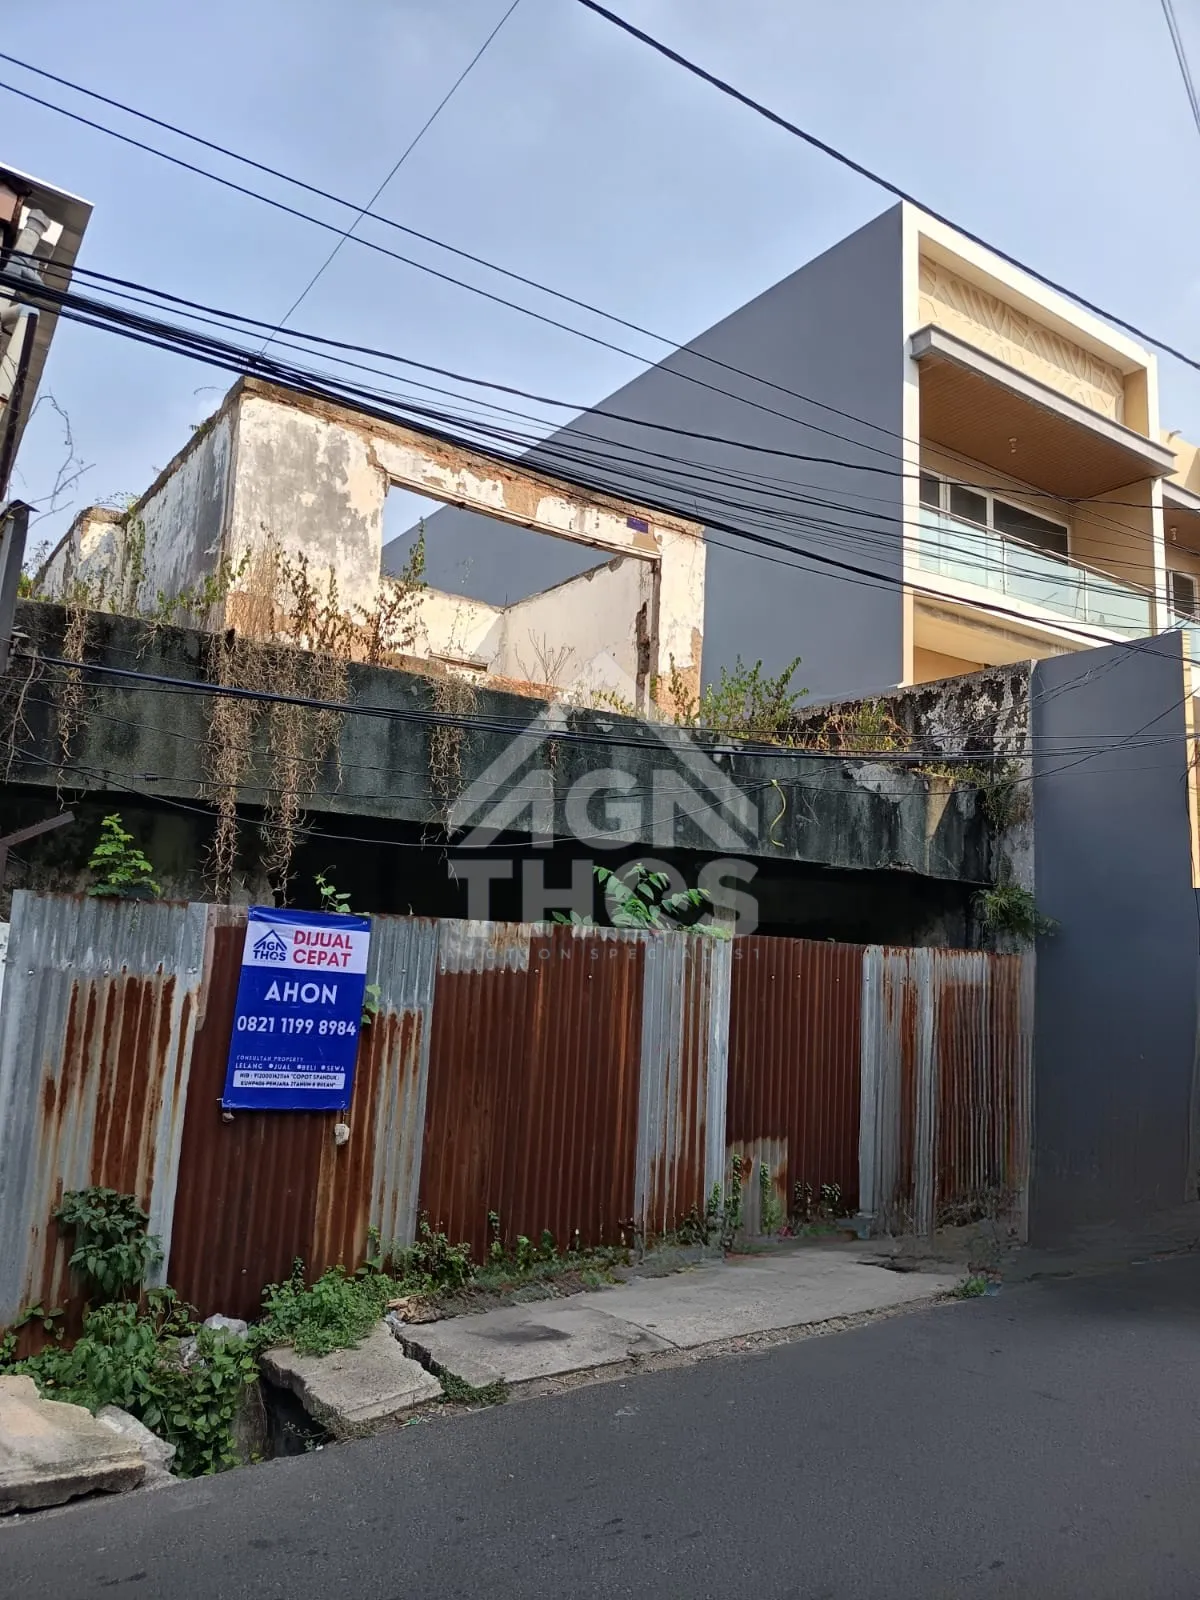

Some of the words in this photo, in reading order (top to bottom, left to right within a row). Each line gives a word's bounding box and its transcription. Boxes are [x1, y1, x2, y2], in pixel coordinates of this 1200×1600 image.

[293, 930, 353, 950] DIJUAL
[252, 949, 287, 962] THOS
[292, 949, 352, 968] CEPAT
[263, 980, 338, 1005] AHON
[236, 1015, 275, 1033] 0821
[281, 1017, 314, 1035] 1199
[318, 1019, 357, 1037] 8984
[235, 1062, 263, 1070] LELANG
[273, 1063, 291, 1071] JUAL
[301, 1064, 317, 1072] BELI
